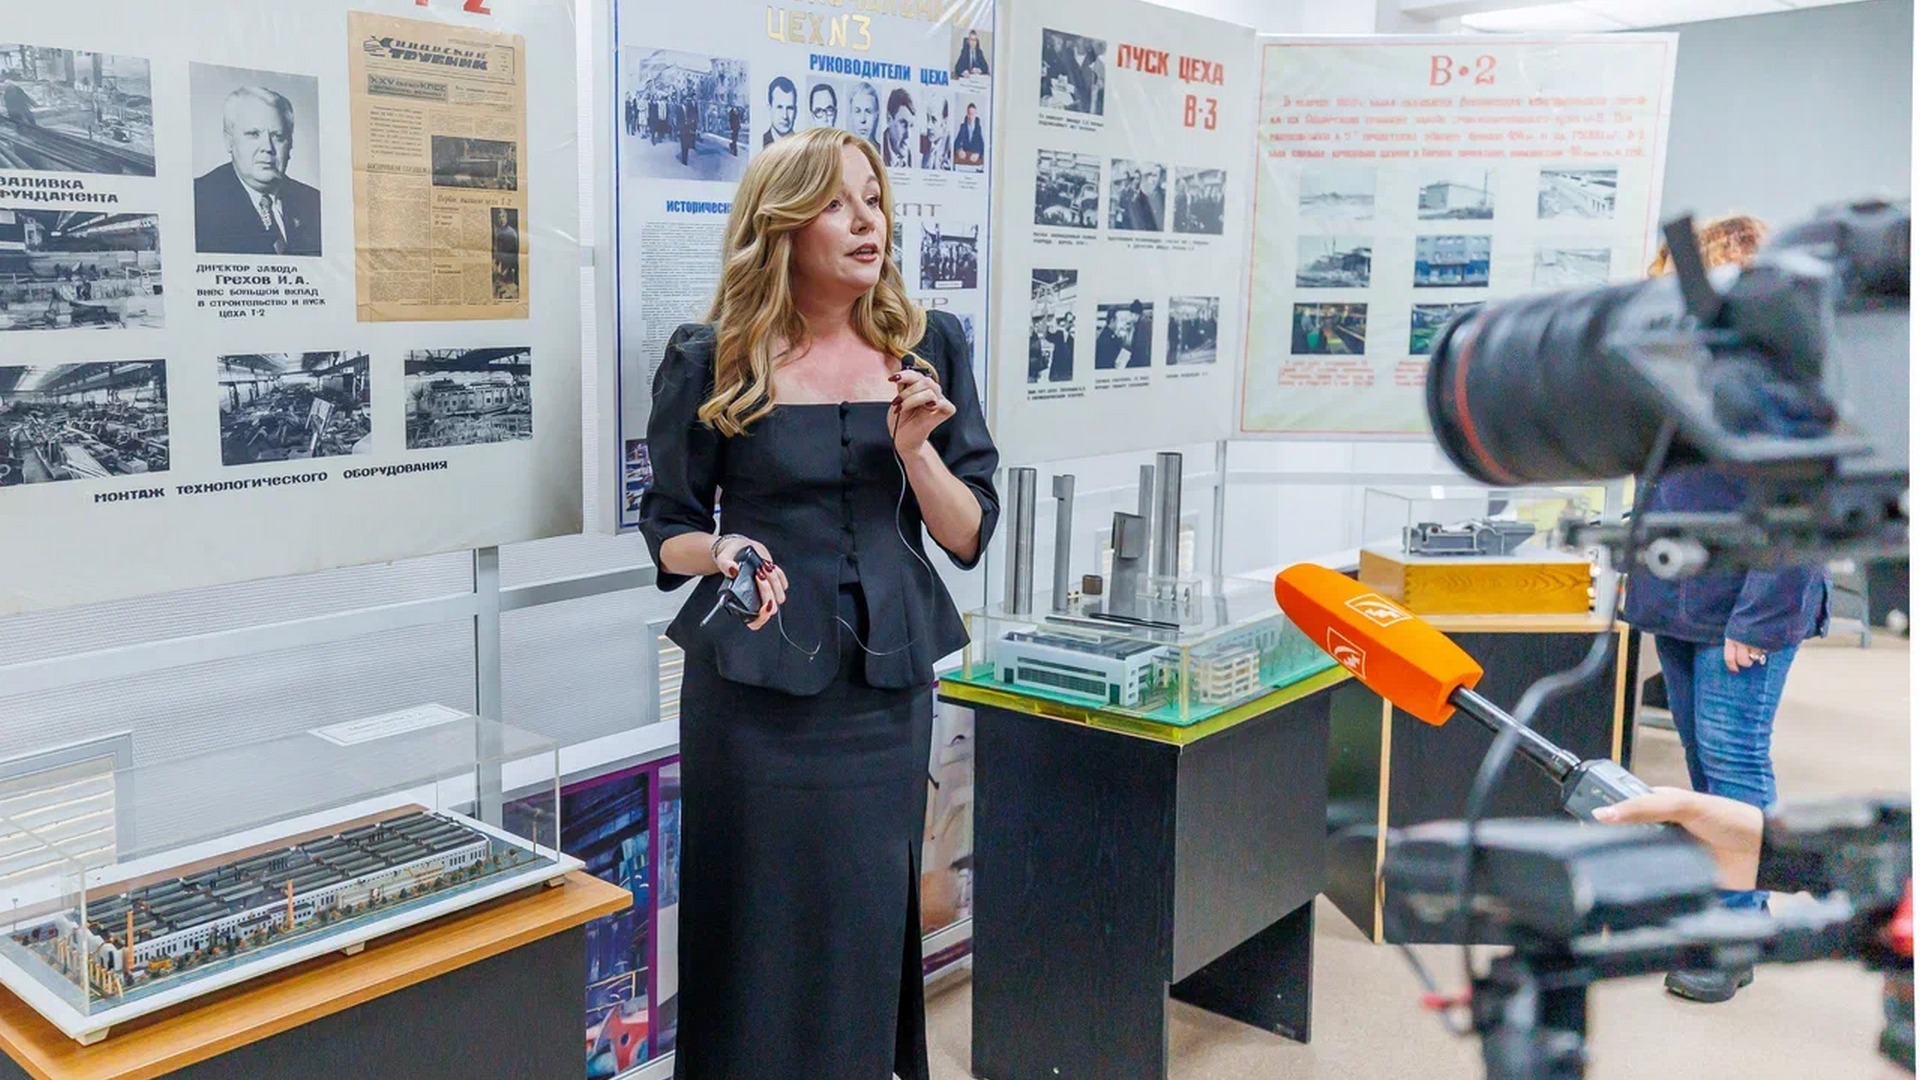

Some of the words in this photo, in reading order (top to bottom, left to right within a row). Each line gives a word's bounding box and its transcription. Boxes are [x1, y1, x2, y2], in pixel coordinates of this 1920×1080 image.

[767, 5, 825, 47] ЦЕХ
[389, 48, 488, 70] ТРУБНИК
[1117, 43, 1170, 76] ПУСК
[1178, 56, 1224, 86] ЦЕХА
[809, 53, 911, 82] РУКОВОДИТЕЛИ
[920, 68, 949, 87] ЦЕХА
[196, 264, 250, 273] ДИРЕКТОР
[257, 265, 298, 274] ЗАВОДА
[215, 275, 271, 285] ГРЕХОВ
[197, 288, 224, 296] ВНЕС
[229, 287, 279, 296] БОЛЬШОЙ
[284, 288, 319, 297] ВКЛАД
[209, 299, 288, 307] СТРОИТЕЛЬСТВО
[302, 298, 326, 306] ПУСК
[219, 310, 246, 319] ЦЕХА
[94, 486, 165, 504] МОНТАЖ
[176, 470, 328, 496] ТЕХНОЛОГИЧЕСКОГО
[343, 460, 448, 480] ОБОРУДОВАНИЯ
